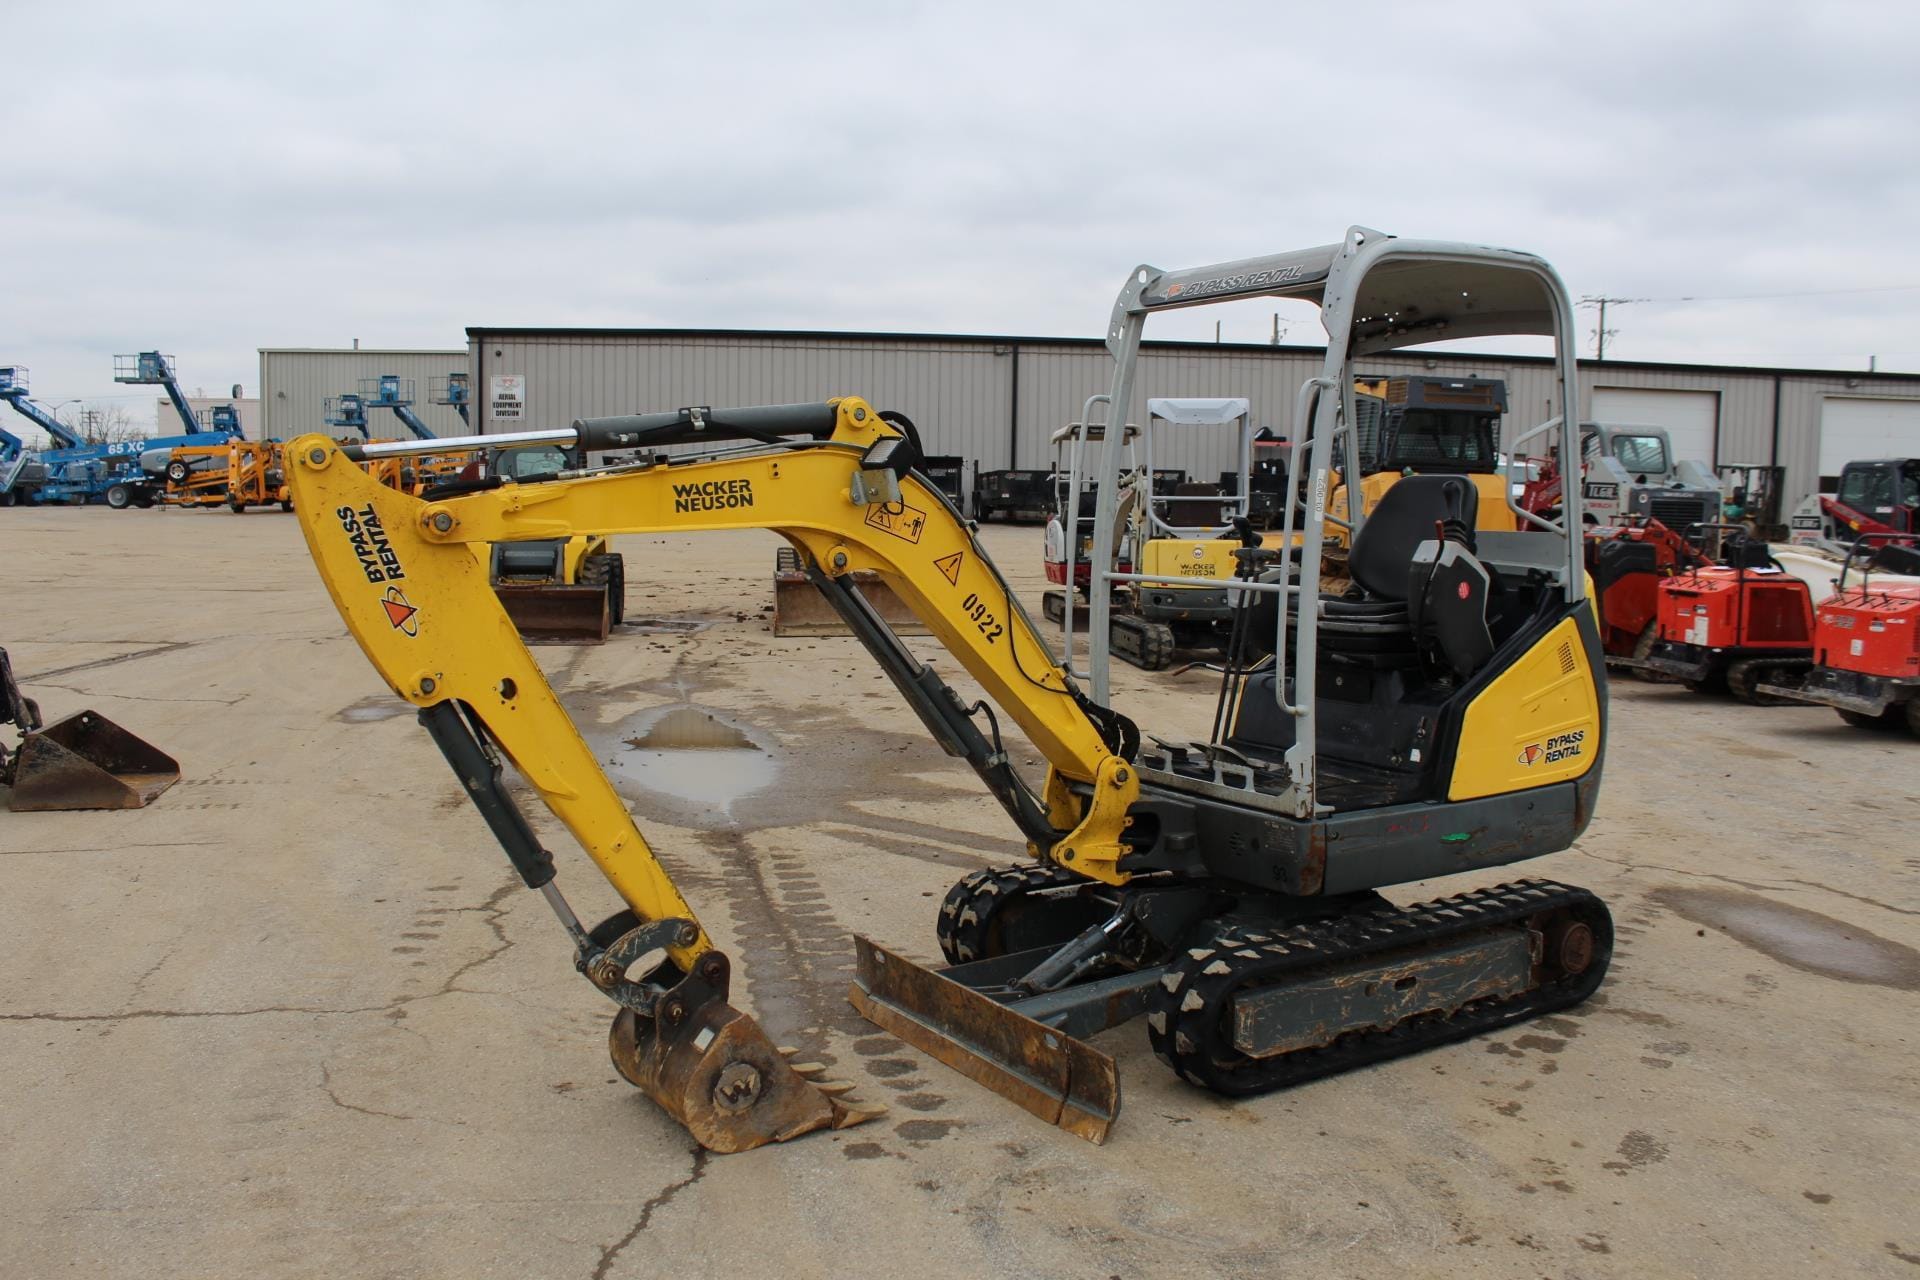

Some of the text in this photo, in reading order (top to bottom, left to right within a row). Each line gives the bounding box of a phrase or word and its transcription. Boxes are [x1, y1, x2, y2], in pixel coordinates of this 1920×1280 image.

[1183, 264, 1304, 297] BYPASS RENTAL
[108, 443, 124, 455] 65
[127, 441, 145, 453] XC
[672, 479, 752, 498] WACKER
[675, 493, 753, 513] NEUSON
[337, 506, 386, 583] BYPASS
[358, 502, 405, 580] RENTAL
[962, 593, 1003, 645] 0922
[1547, 730, 1584, 751] BYPASS
[1545, 744, 1581, 764] RENTAL
